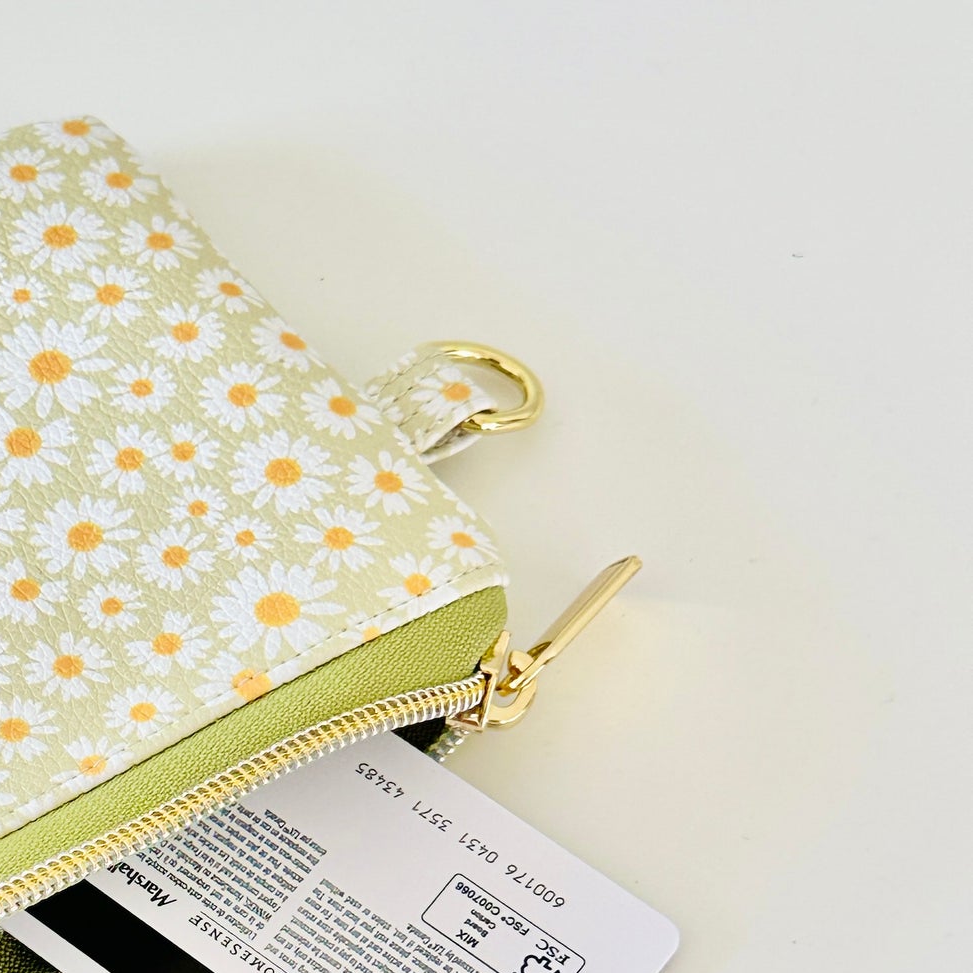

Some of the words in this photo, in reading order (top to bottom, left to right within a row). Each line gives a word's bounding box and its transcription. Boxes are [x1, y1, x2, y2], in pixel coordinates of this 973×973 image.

[354, 762, 405, 799] 43485
[411, 800, 453, 833] 3571
[458, 832, 499, 864] 0431
[504, 864, 565, 908] 600176
[455, 928, 480, 949] MIX
[463, 918, 489, 938] Board
[535, 938, 571, 966] FSC
